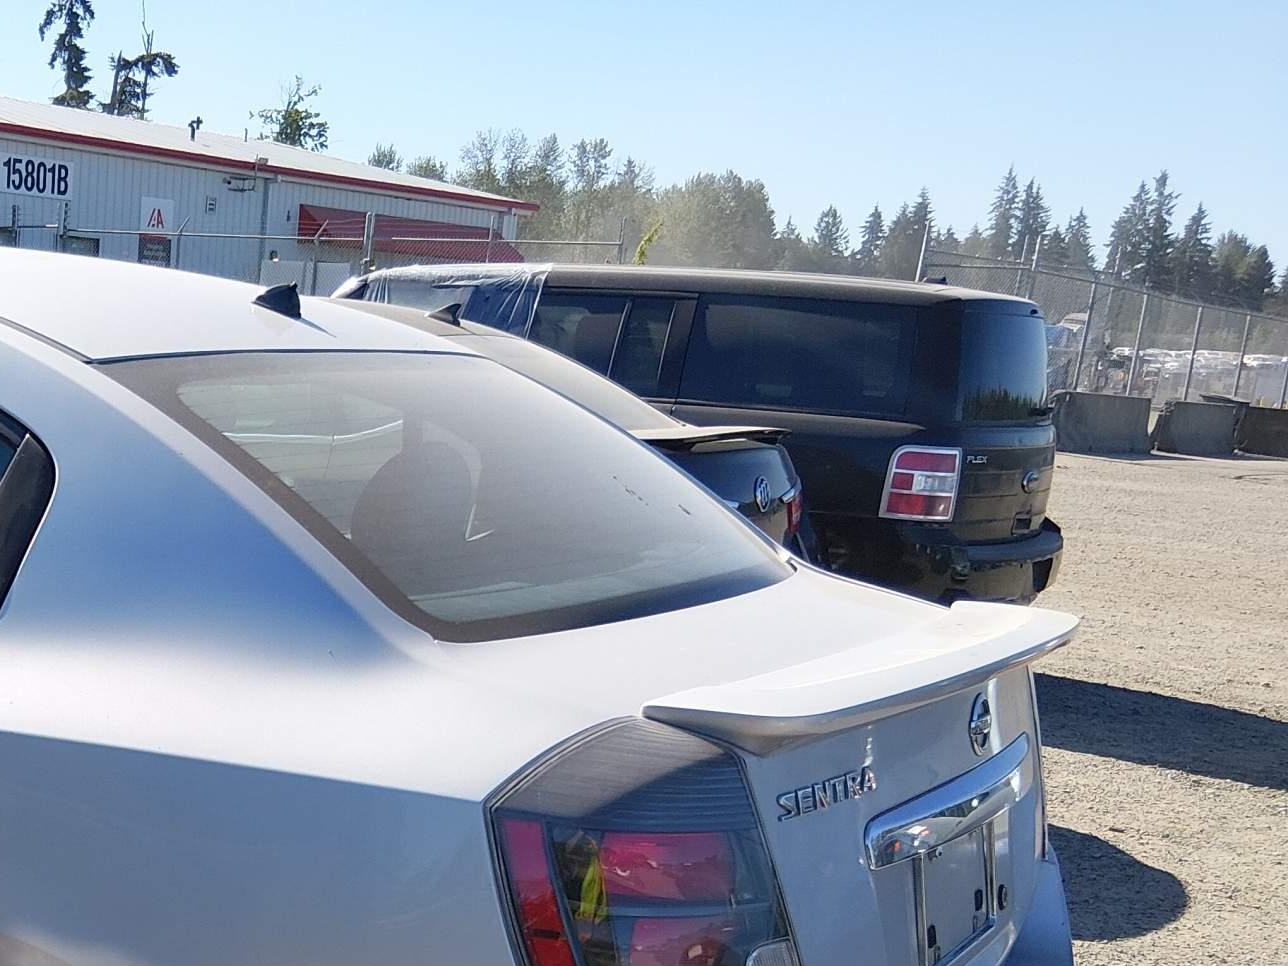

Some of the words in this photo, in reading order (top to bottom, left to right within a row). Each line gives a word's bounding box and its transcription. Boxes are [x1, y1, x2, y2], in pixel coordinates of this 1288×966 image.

[3, 156, 69, 195] 15801B
[966, 455, 988, 464] FLEX
[776, 766, 877, 822] SENTRA
